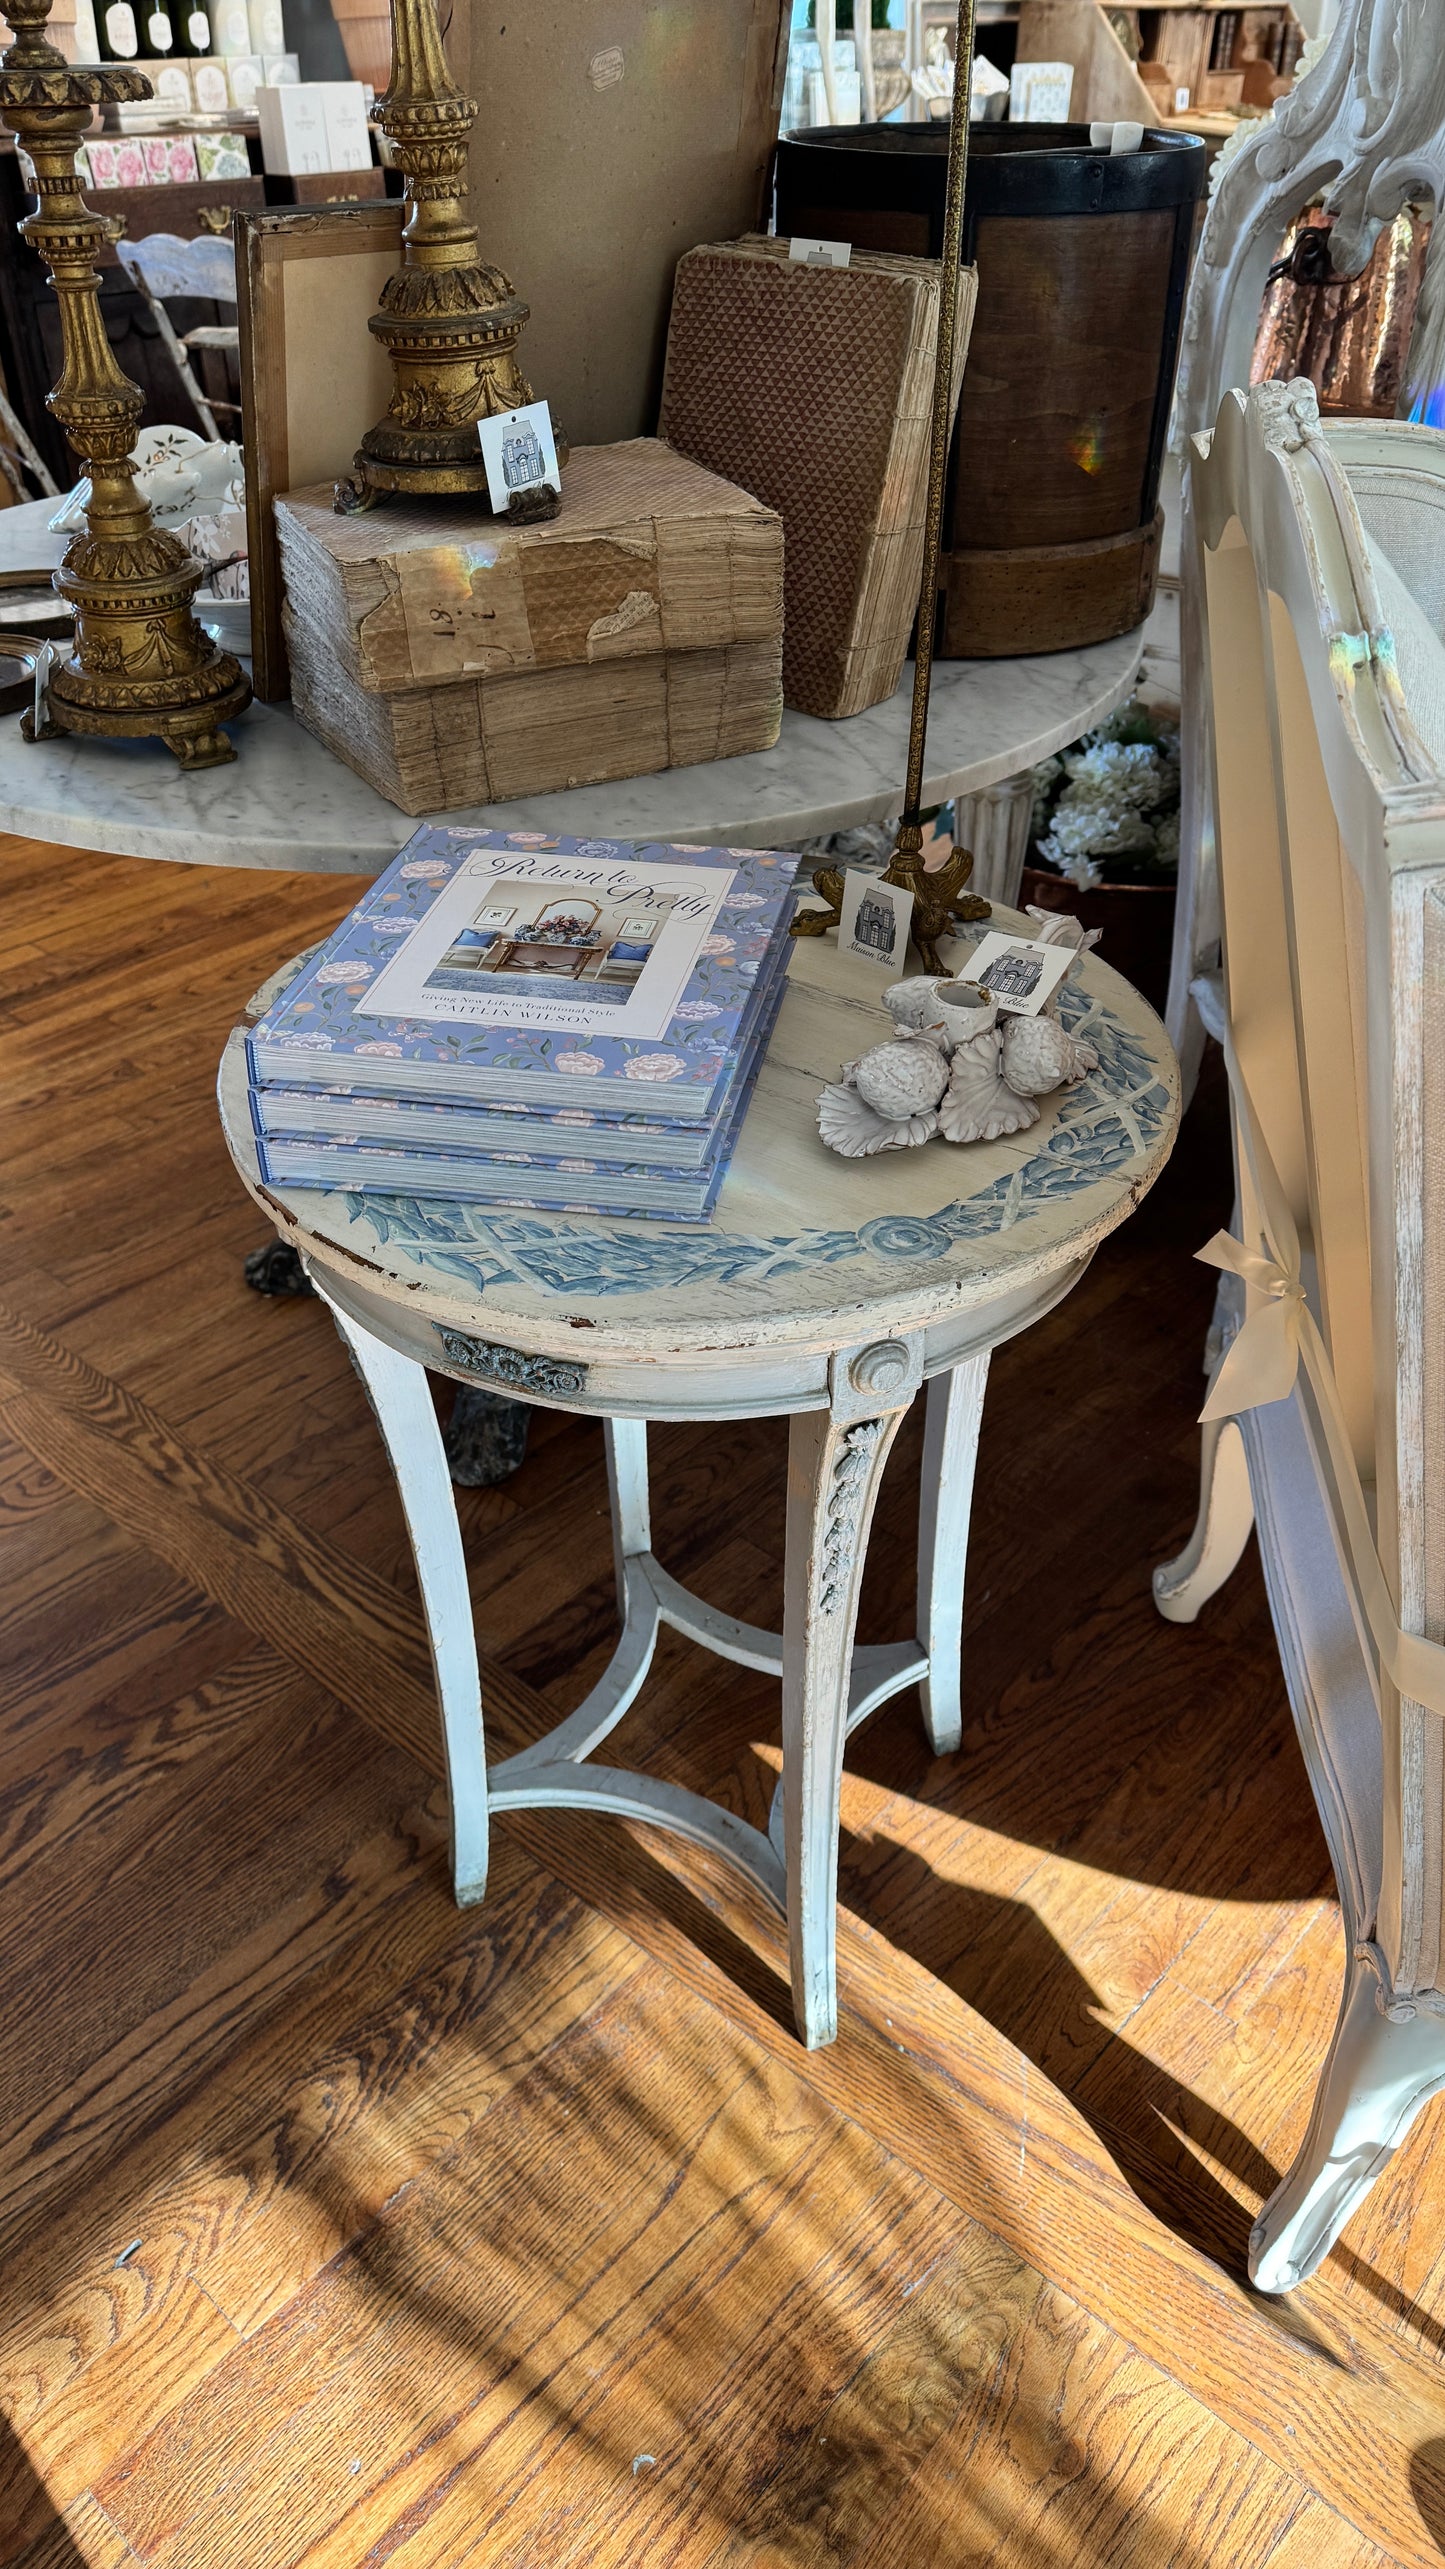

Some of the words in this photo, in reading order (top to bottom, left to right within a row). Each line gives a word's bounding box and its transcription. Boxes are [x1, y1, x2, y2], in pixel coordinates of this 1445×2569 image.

[472, 856, 606, 888] Return
[607, 869, 638, 884] to
[602, 881, 716, 924] Pretty
[846, 941, 875, 959] Maison
[876, 952, 896, 968] Blue
[421, 993, 457, 1004] Giving
[461, 996, 483, 1005] New
[487, 999, 509, 1007] Life
[525, 1002, 586, 1014] Traditional
[588, 1009, 616, 1018] Style
[434, 1003, 512, 1017] CAITLIN
[520, 1011, 593, 1025] WILSON
[1002, 997, 1029, 1009] Blue
